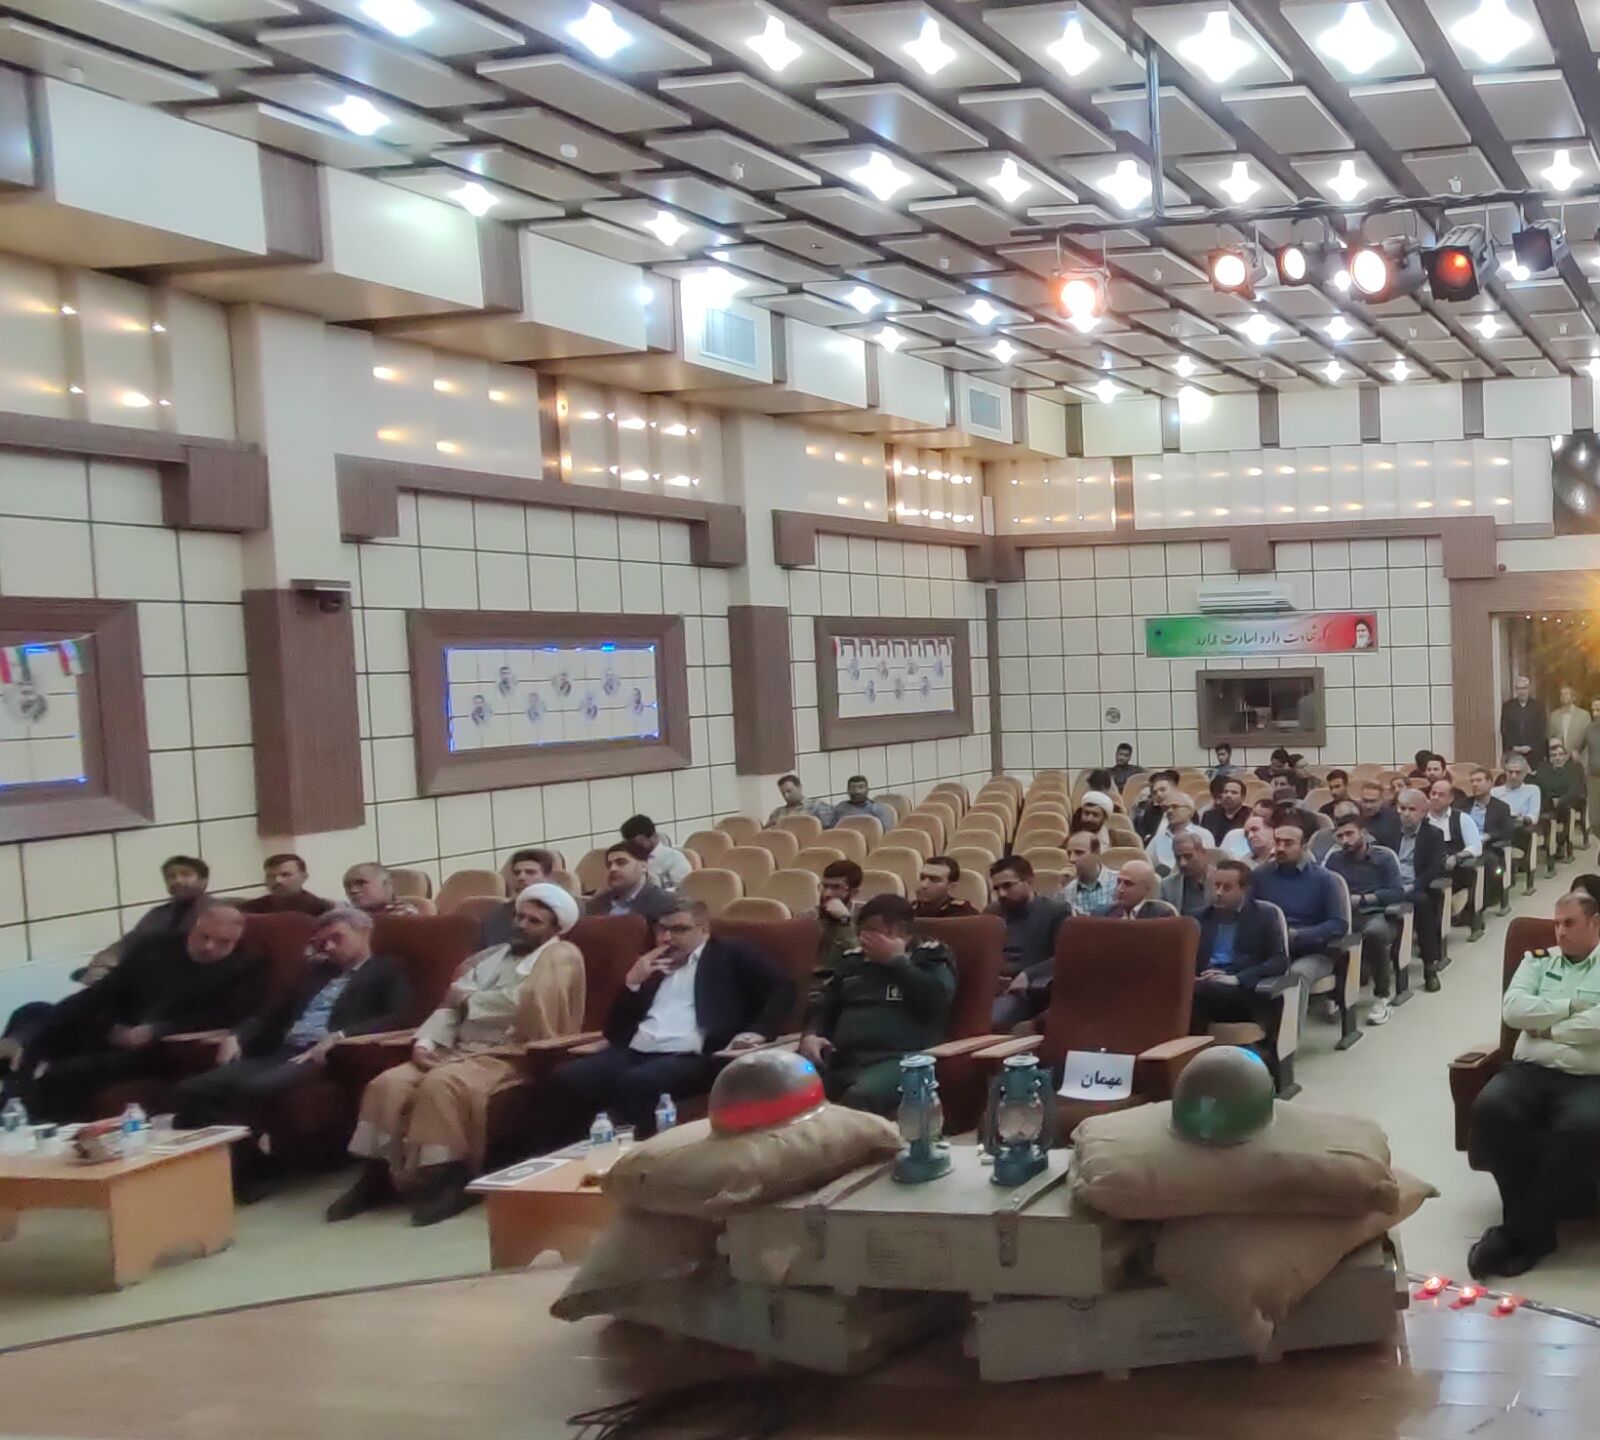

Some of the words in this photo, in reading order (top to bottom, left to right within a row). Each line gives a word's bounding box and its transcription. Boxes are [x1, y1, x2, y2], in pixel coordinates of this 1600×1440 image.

[1197, 632, 1217, 646] ندارد
[1221, 631, 1258, 645] اسارت
[1261, 630, 1281, 644] دارد
[1081, 1070, 1123, 1089] مهمان
